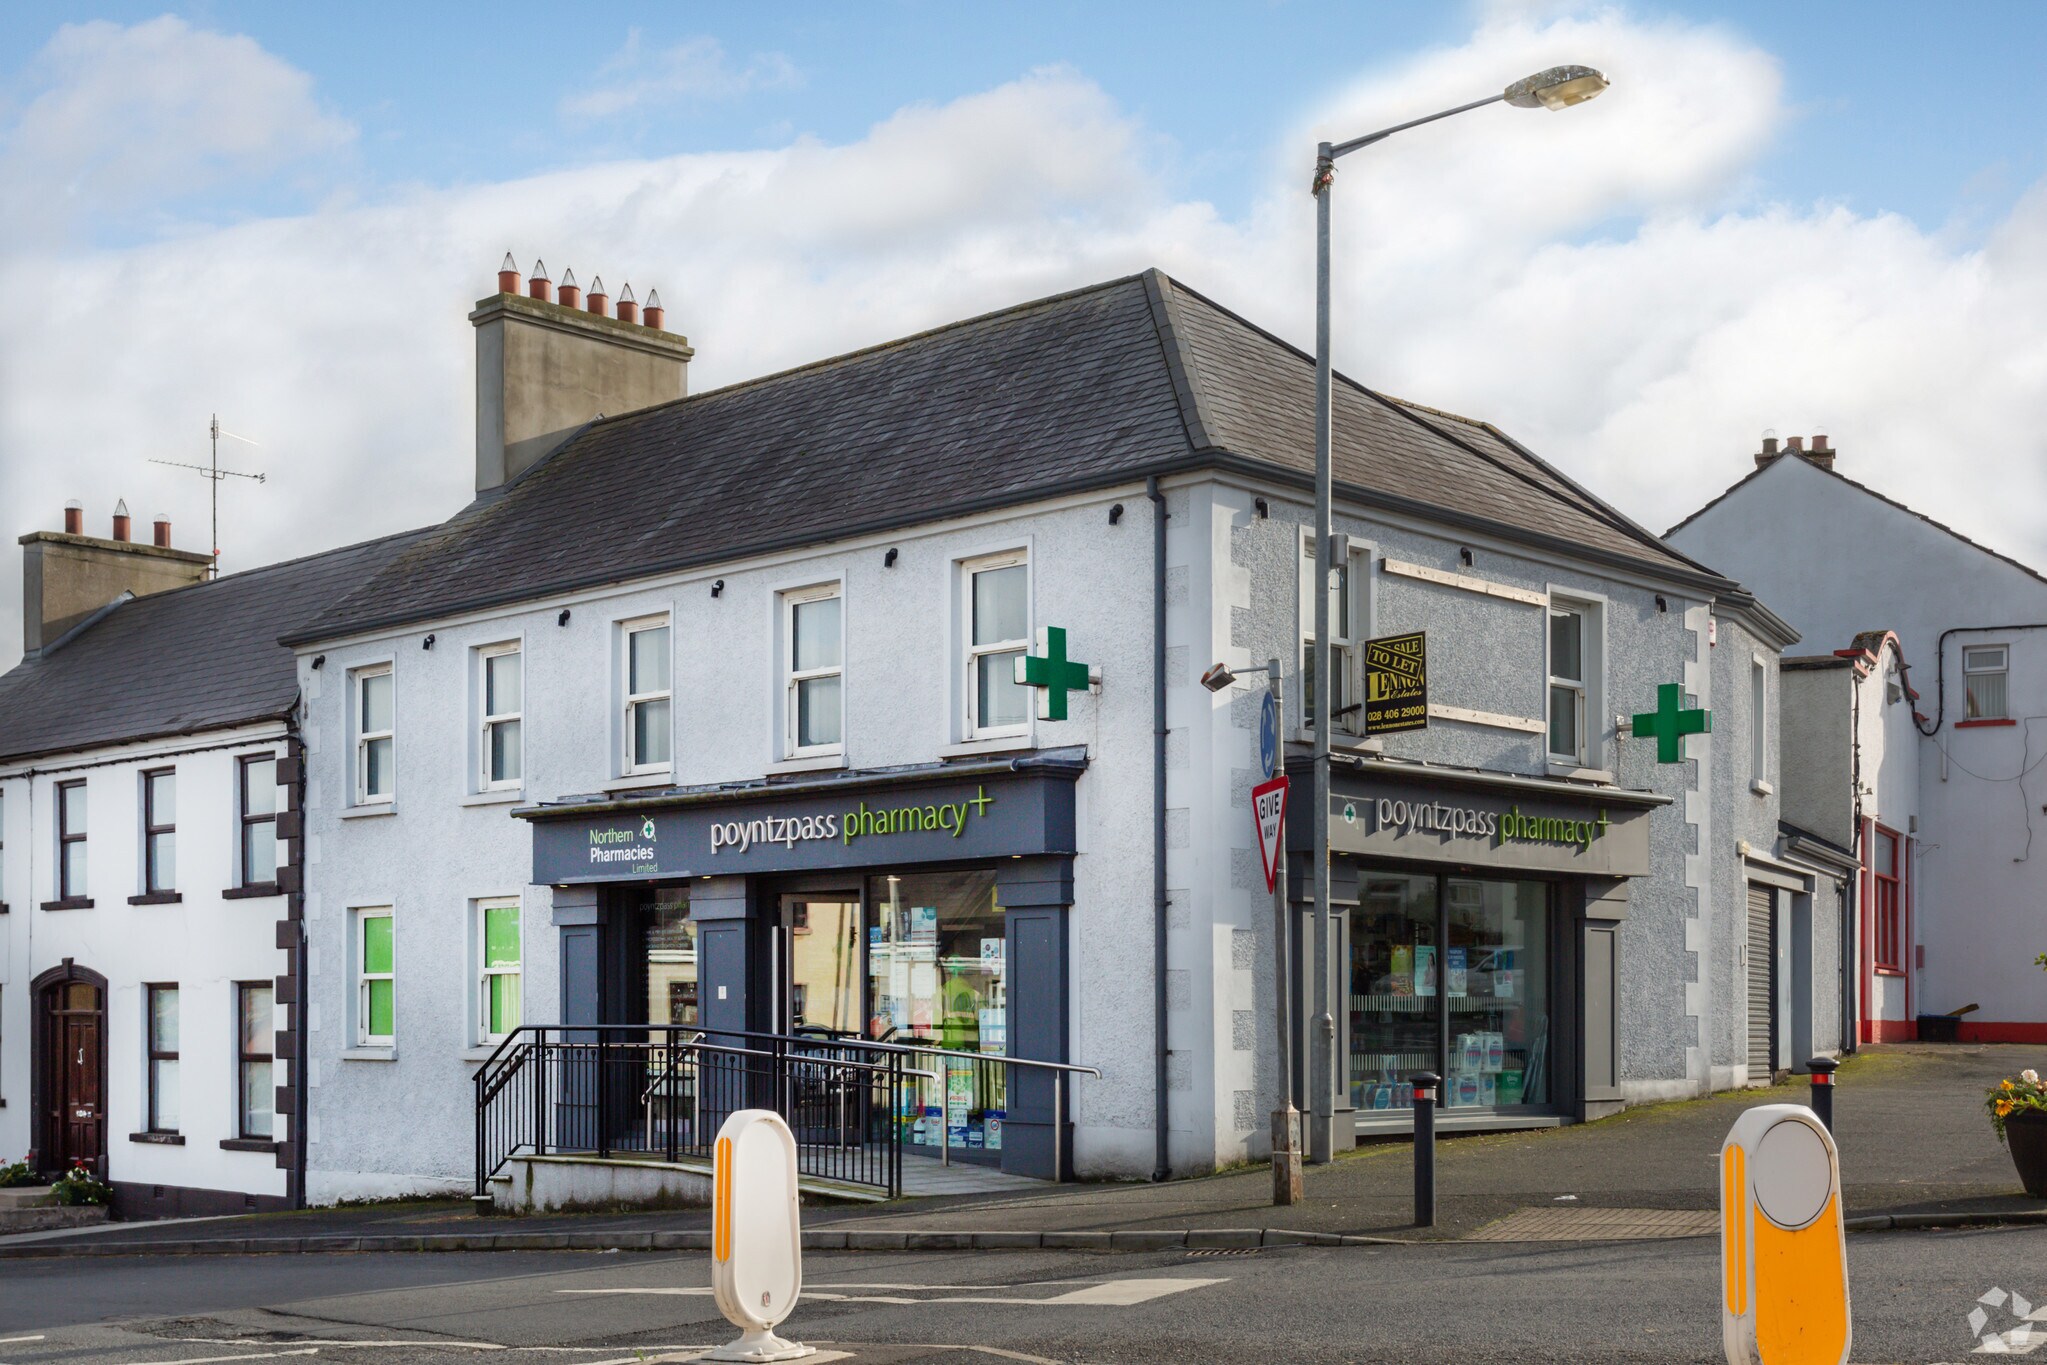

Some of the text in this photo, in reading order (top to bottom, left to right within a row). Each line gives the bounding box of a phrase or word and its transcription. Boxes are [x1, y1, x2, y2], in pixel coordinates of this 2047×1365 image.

[1372, 649, 1418, 673] TO LET
[1390, 689, 1423, 700] Estates
[1367, 705, 1425, 721] 028 406 29000
[1259, 792, 1279, 820] GIVE
[1377, 798, 1498, 840] poyntzpass
[589, 828, 634, 845] Northern
[711, 814, 838, 854] poyntzpass
[1264, 822, 1277, 840] WAY
[590, 844, 654, 864] Pharmacies
[632, 863, 658, 874] Limited
